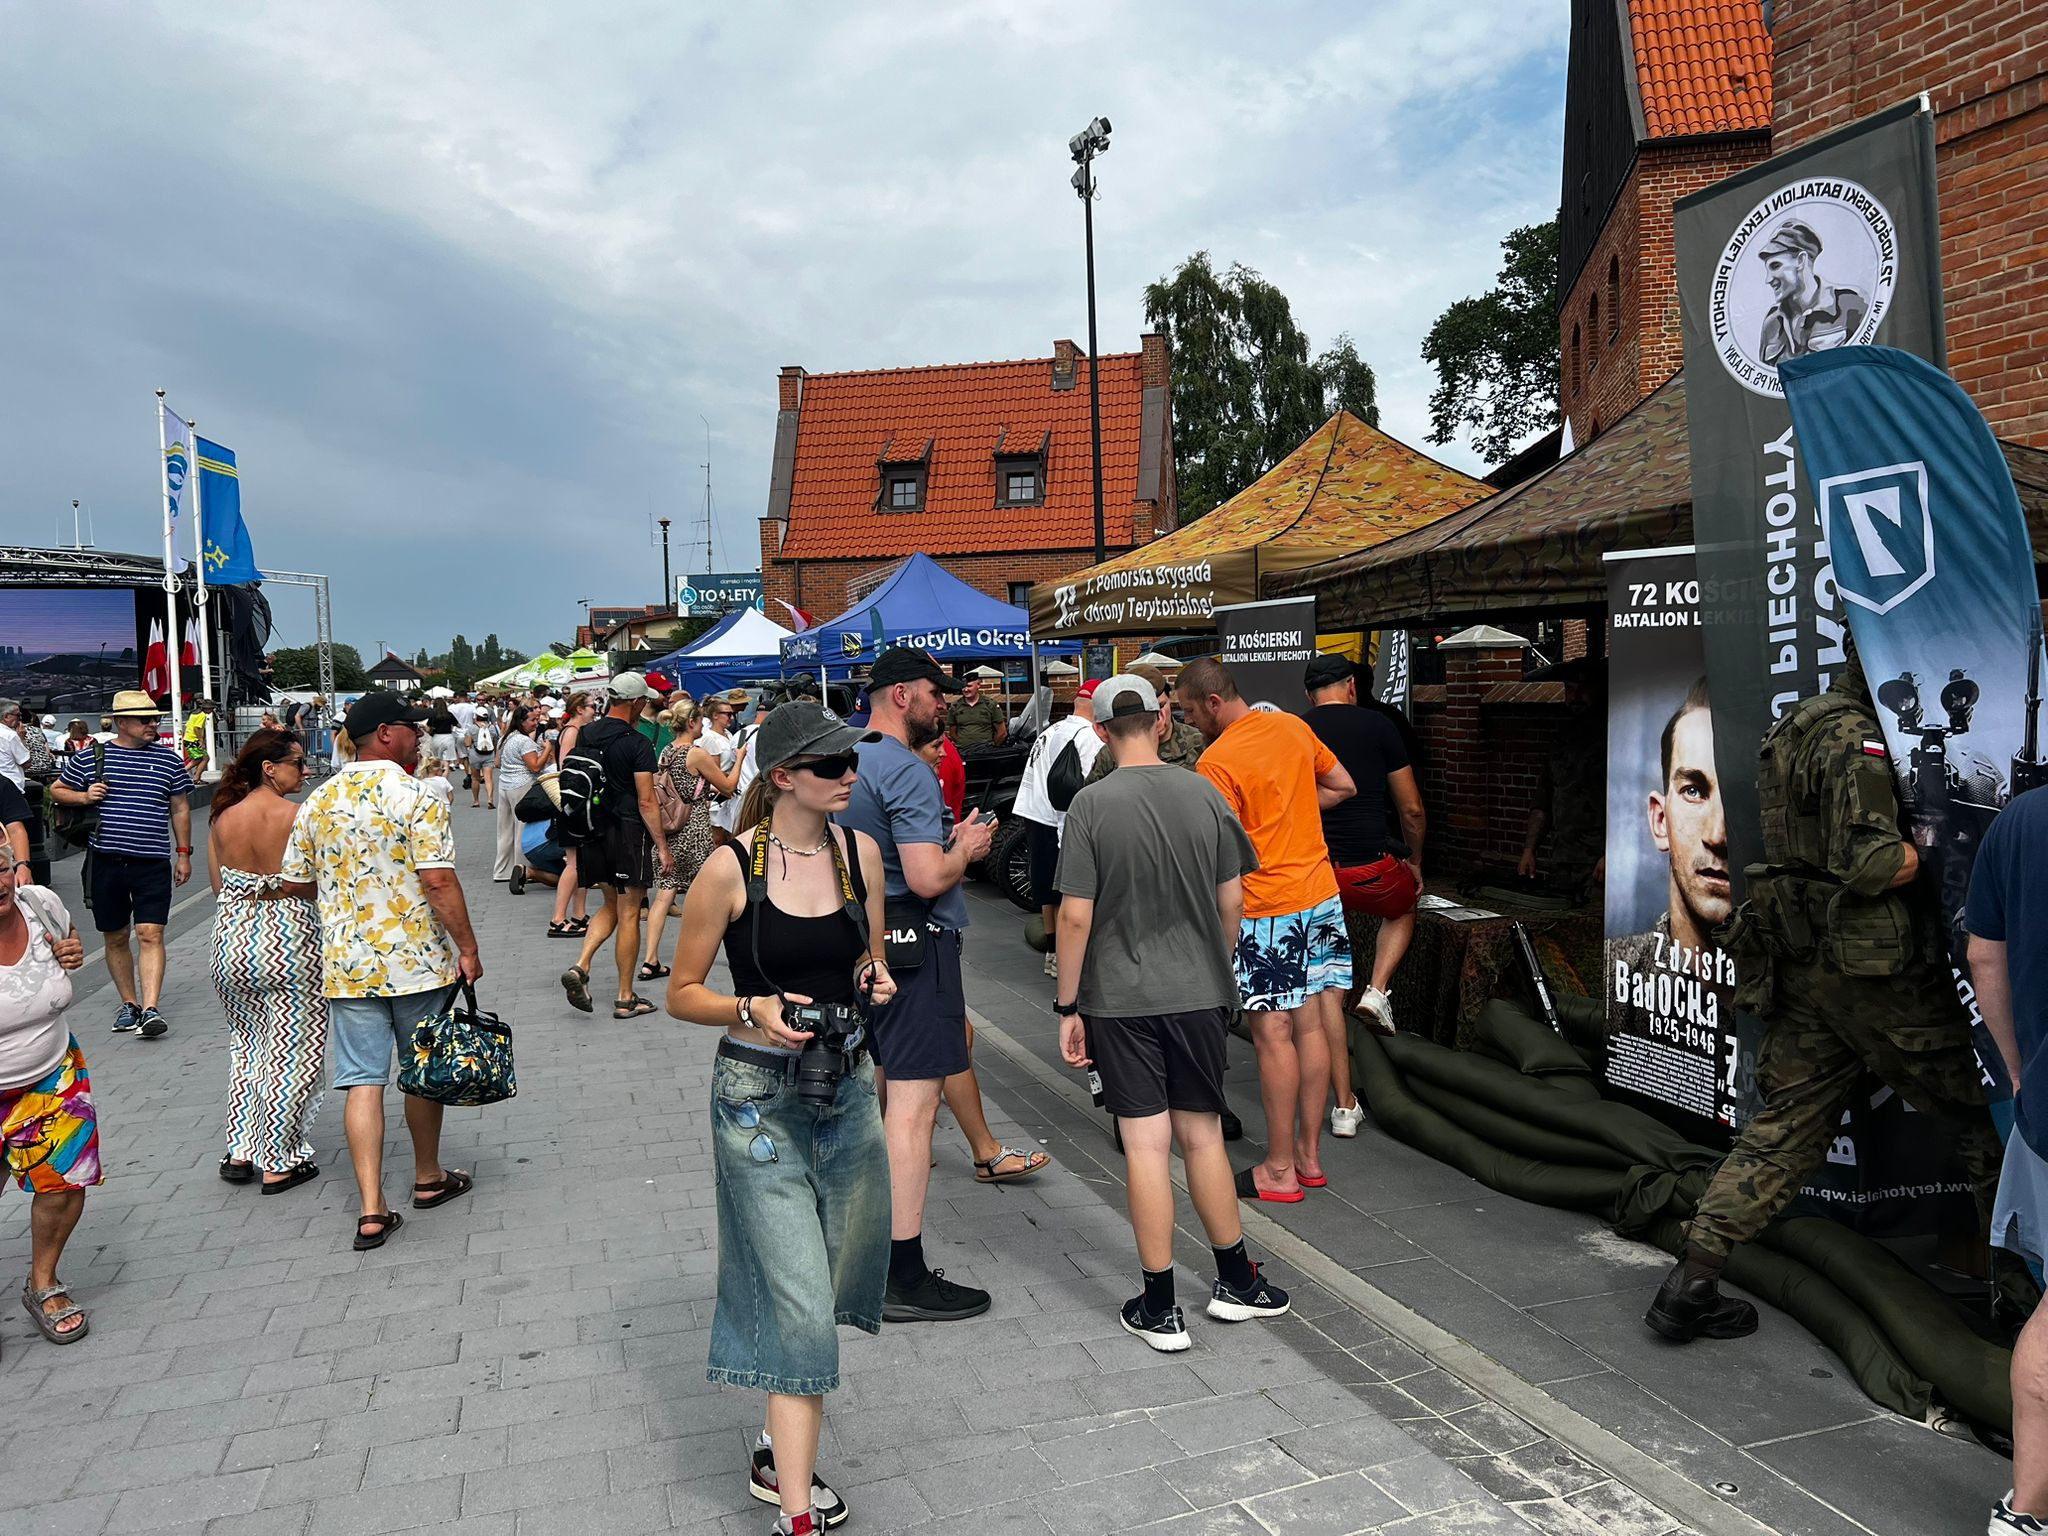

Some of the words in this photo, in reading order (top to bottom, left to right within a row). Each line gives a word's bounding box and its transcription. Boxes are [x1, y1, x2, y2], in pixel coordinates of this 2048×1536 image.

[1096, 567, 1154, 594] Pomorska
[1155, 558, 1212, 589] Brygada
[699, 588, 757, 602] TOALETY
[1084, 601, 1125, 624] Obrony
[1127, 590, 1215, 621] Terytorialnej
[1628, 583, 1658, 607] 72
[1614, 611, 1689, 628] BATALION
[895, 627, 972, 651] Flotylla
[1225, 634, 1237, 650] 72
[1239, 629, 1302, 649] KOŚCIERSKI
[1249, 651, 1276, 662] LEKKIEJ
[1277, 650, 1312, 660] PIECHOTY
[753, 843, 764, 876] Nikon
[841, 870, 854, 900] Nikon
[1653, 932, 1737, 988] Zdzisła
[1649, 1013, 1716, 1056] 1925-1946
